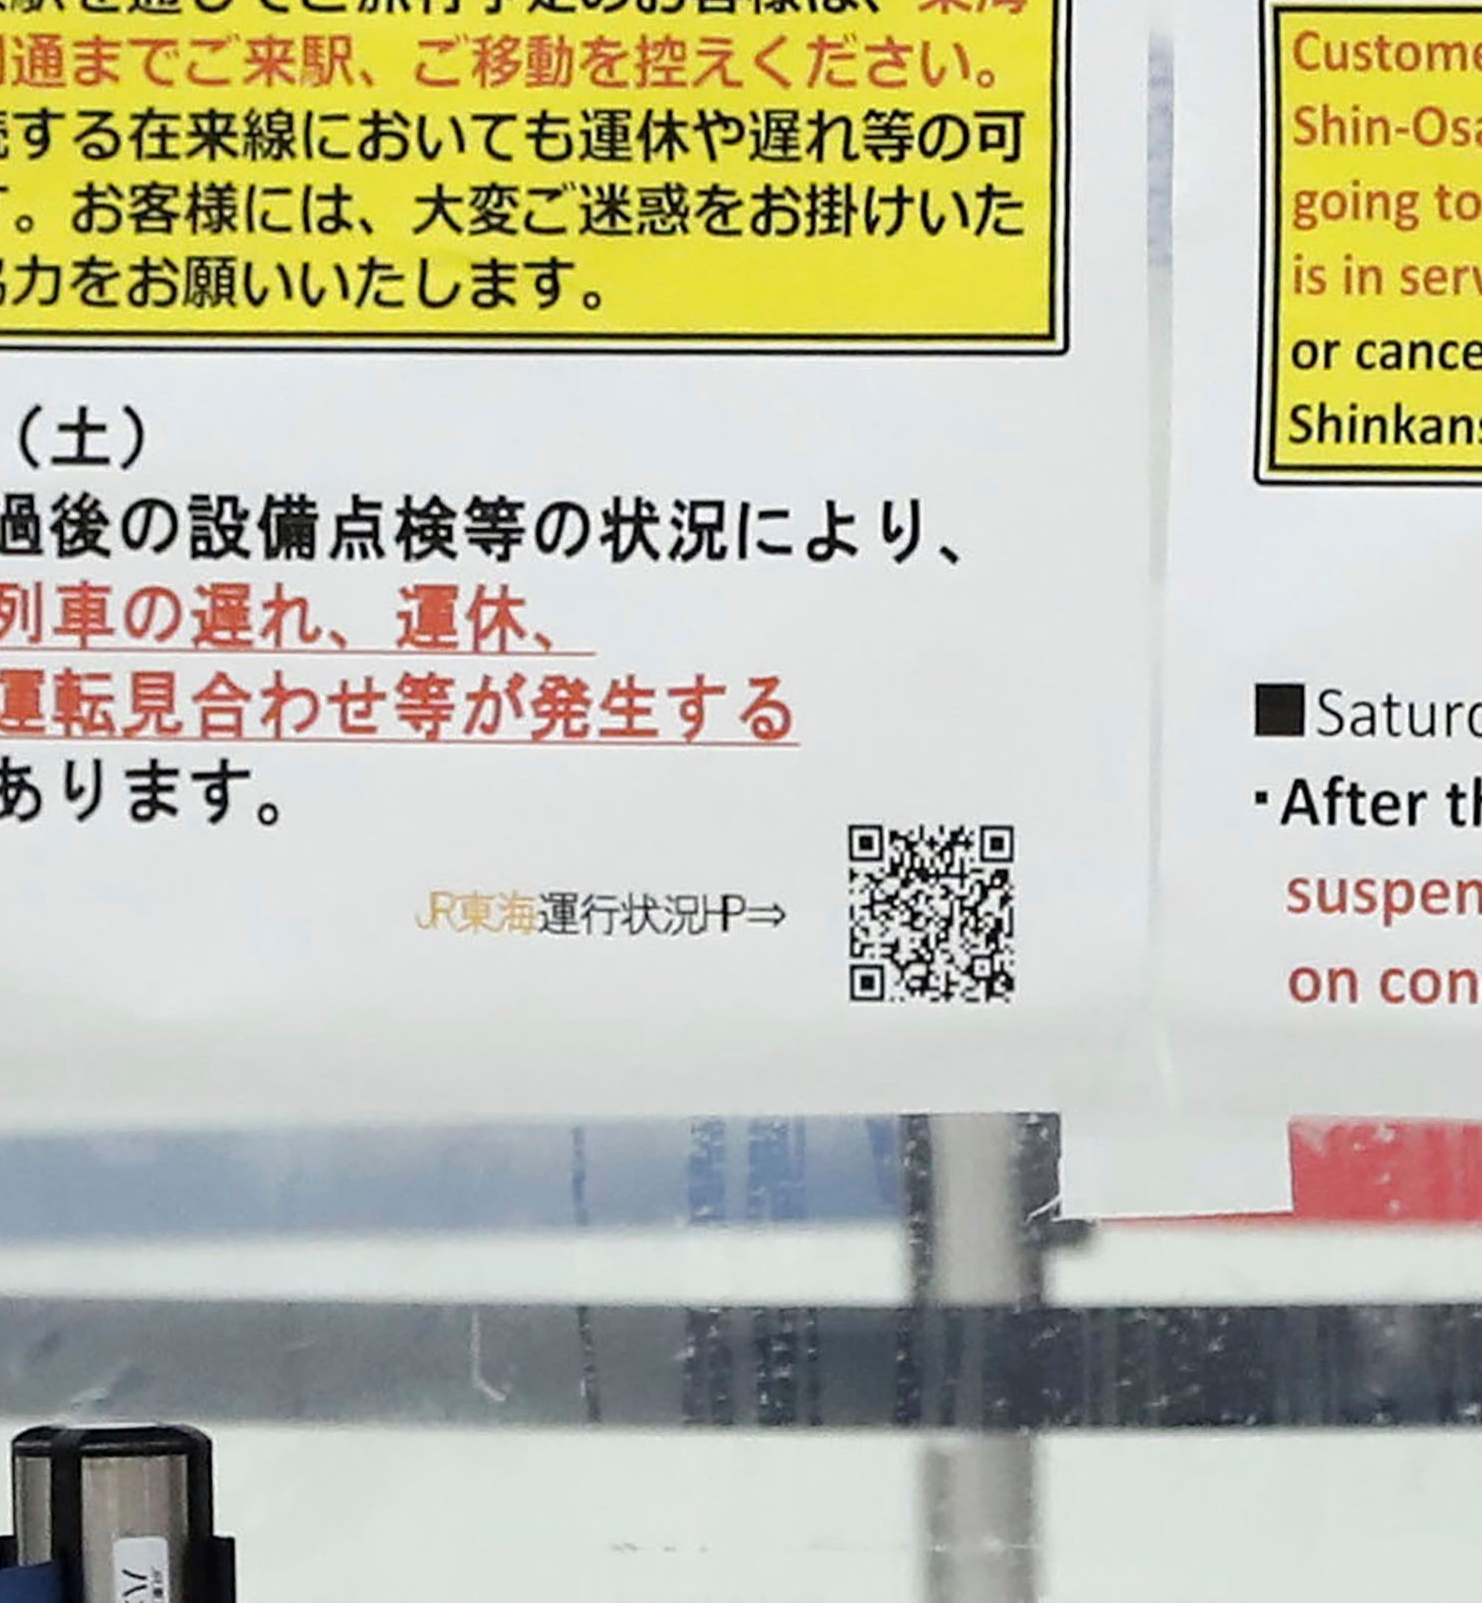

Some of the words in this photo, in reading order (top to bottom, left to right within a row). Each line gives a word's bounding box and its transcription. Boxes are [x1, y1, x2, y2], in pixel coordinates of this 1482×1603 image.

[1293, 179, 1419, 232] going
[1434, 184, 1482, 221] to
[1295, 254, 1325, 294] is
[1345, 254, 1381, 294] in
[1292, 340, 1340, 370] or
[1281, 775, 1427, 826] After
[1289, 967, 1357, 1003] on
